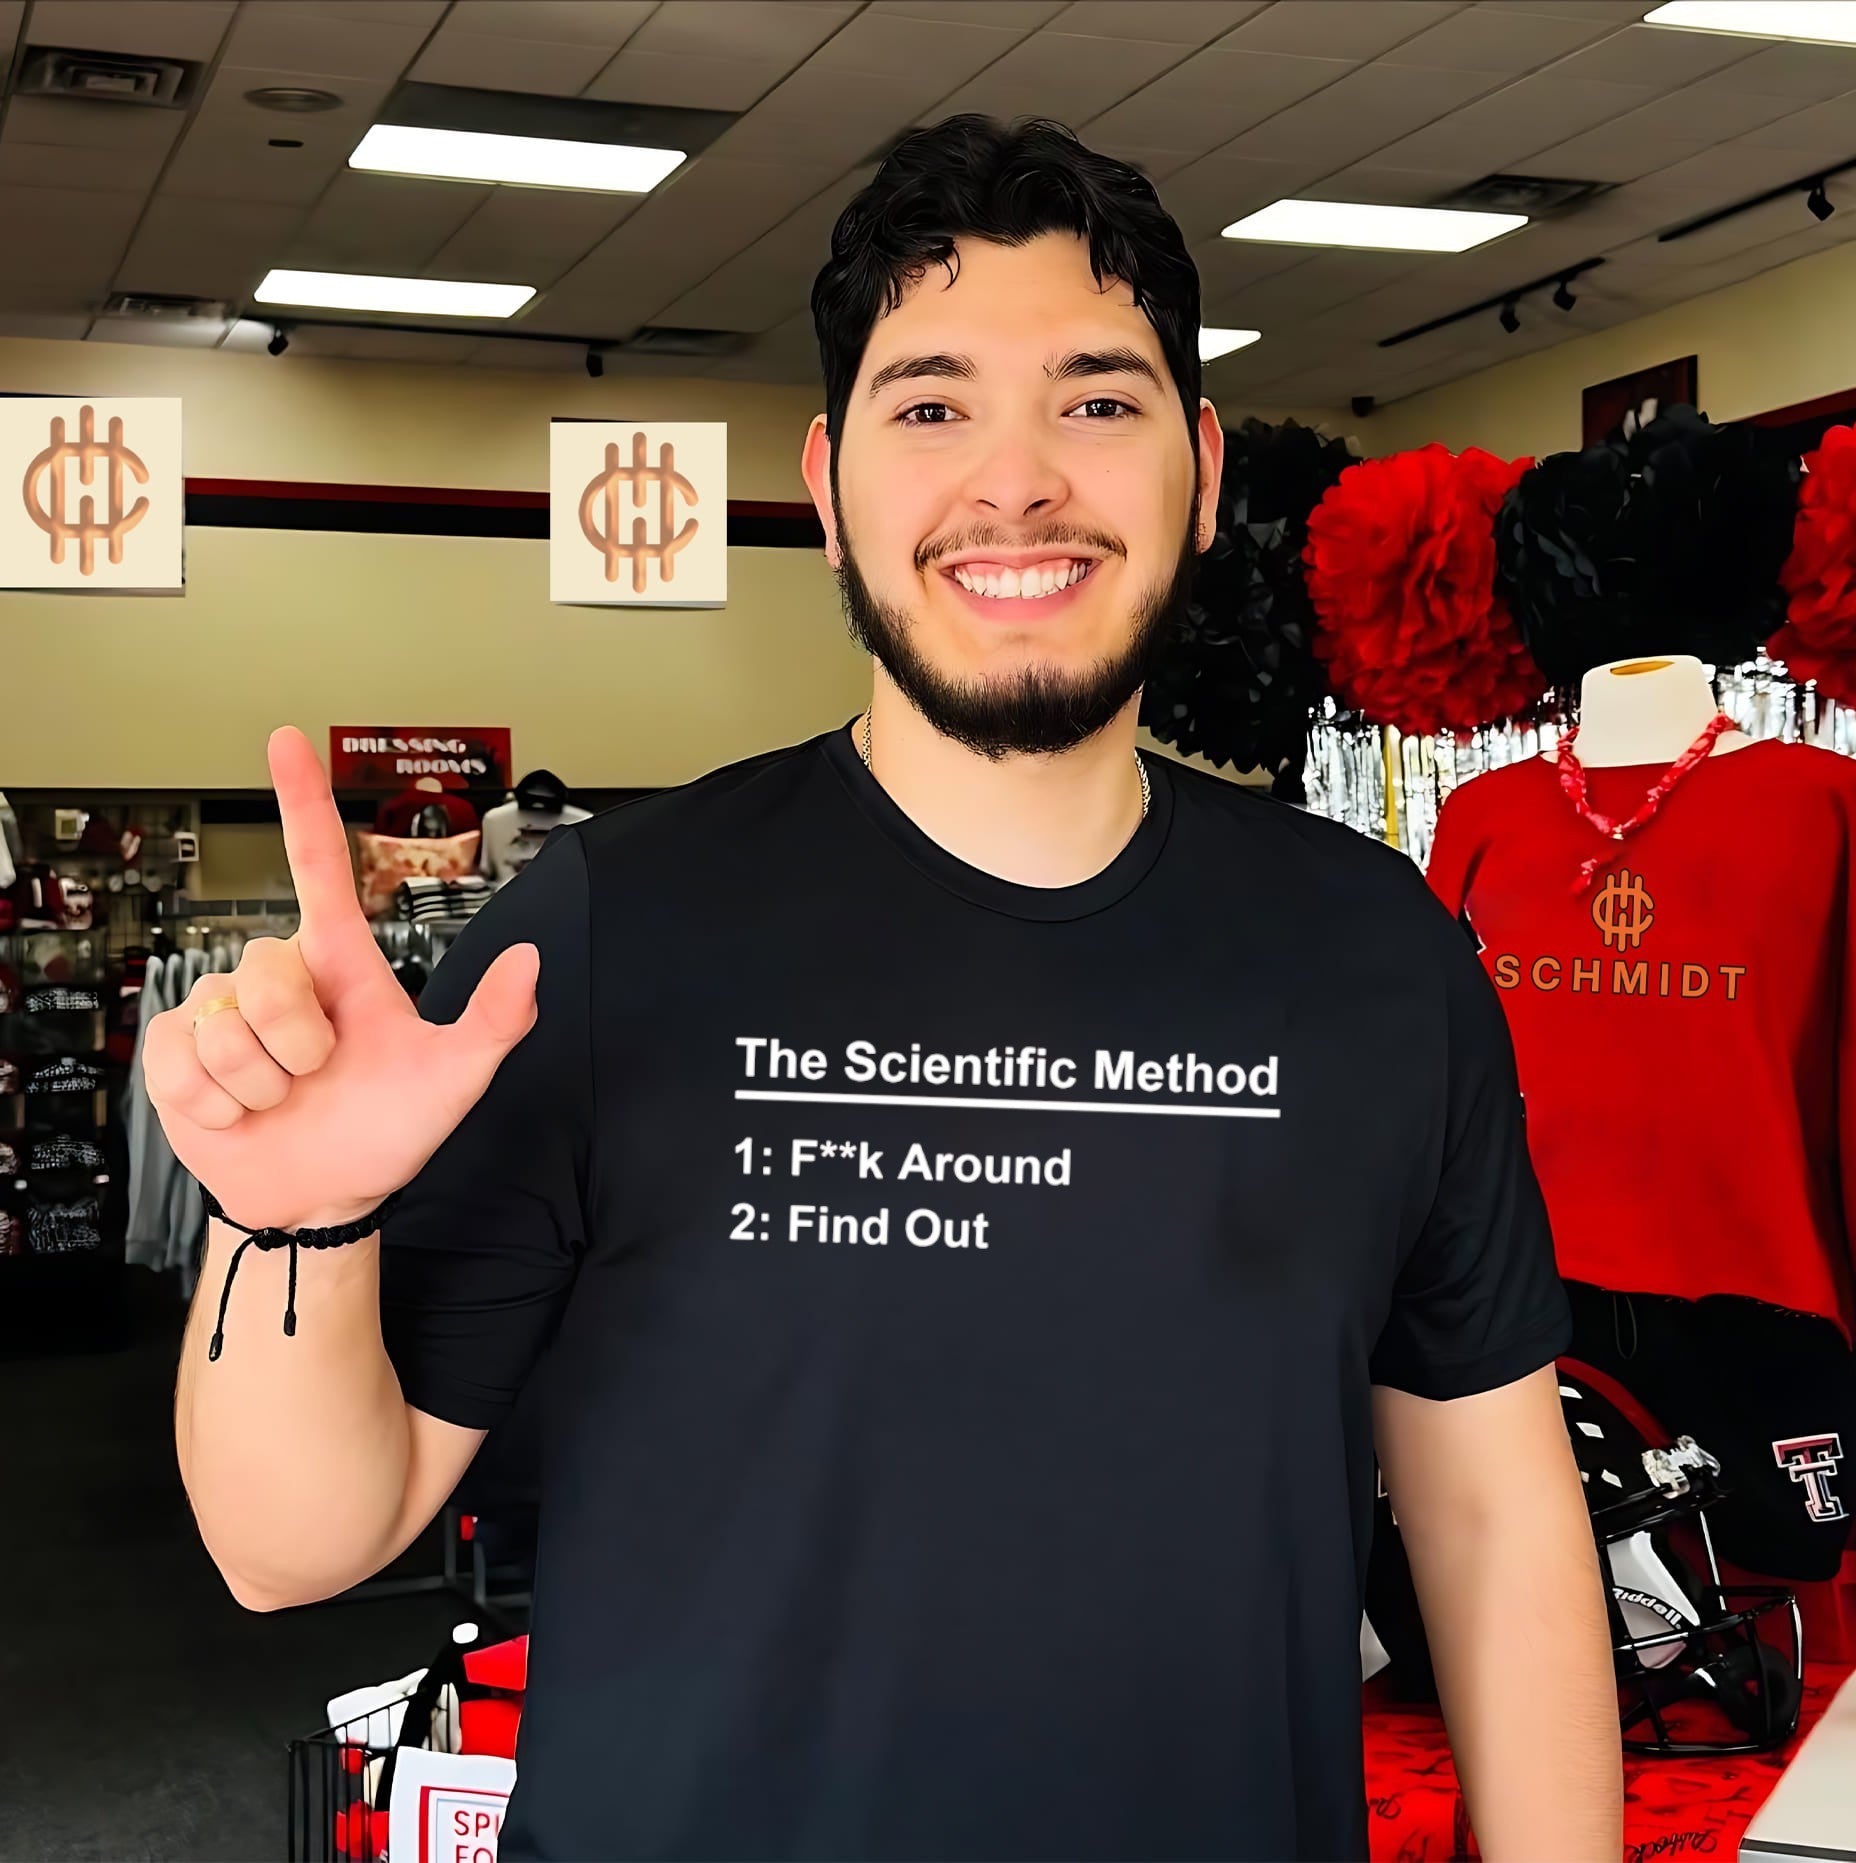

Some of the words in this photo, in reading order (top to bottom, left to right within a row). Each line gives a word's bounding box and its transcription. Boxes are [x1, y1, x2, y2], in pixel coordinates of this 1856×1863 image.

[342, 737, 467, 754] DRESSING
[396, 758, 487, 775] ROOMS
[1494, 953, 1746, 1000] SCHMIDT
[735, 1036, 828, 1081] The
[844, 1040, 1077, 1090] Scientific
[1094, 1049, 1279, 1097] Method
[734, 1136, 772, 1176] 1:
[897, 1142, 1072, 1187] Around
[729, 1202, 770, 1241] 2:
[788, 1204, 889, 1246] Find
[904, 1208, 990, 1250] Out
